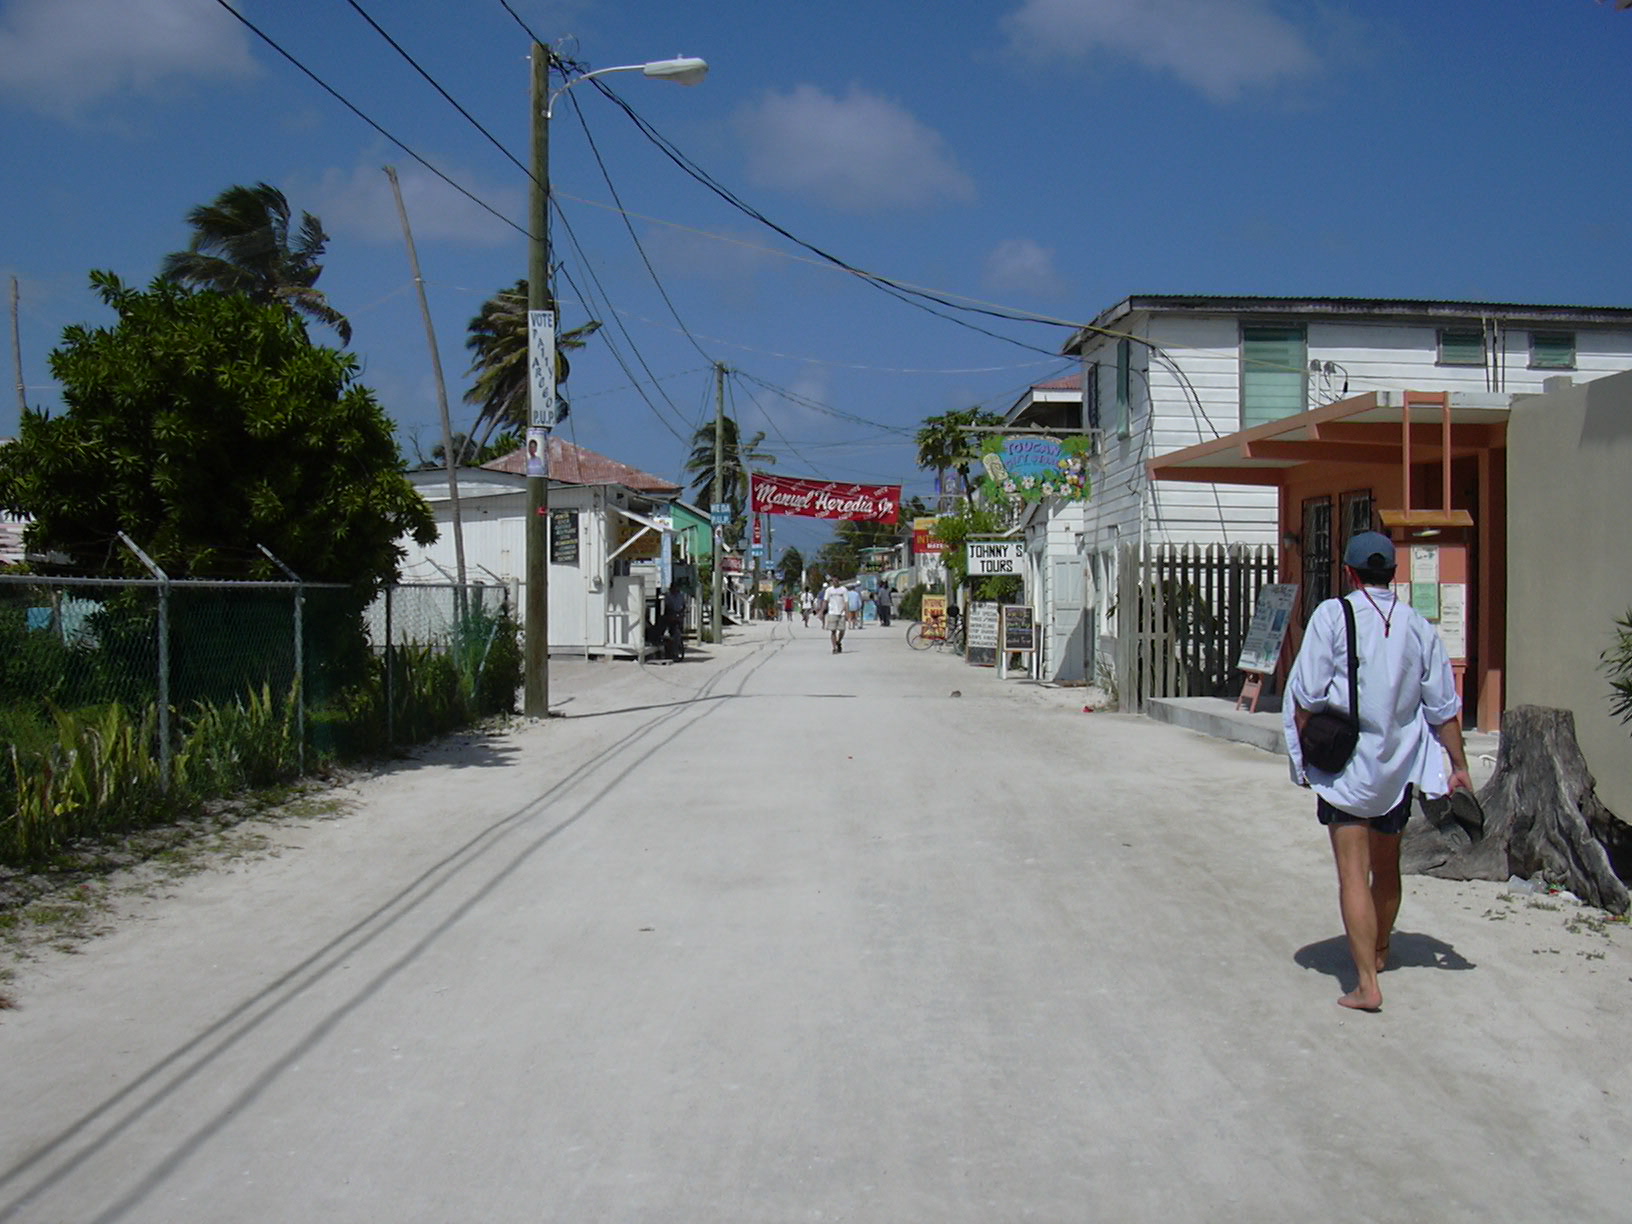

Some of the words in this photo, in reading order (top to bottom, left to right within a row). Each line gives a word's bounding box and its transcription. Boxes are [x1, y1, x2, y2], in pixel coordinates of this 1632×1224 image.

[531, 313, 553, 328] VOTE
[1009, 442, 1062, 458] TOUCAN
[754, 482, 814, 509] Manuel
[814, 490, 874, 513] Heredia
[969, 544, 1023, 558] JOHNNY'S
[980, 560, 1013, 573] TOURS
